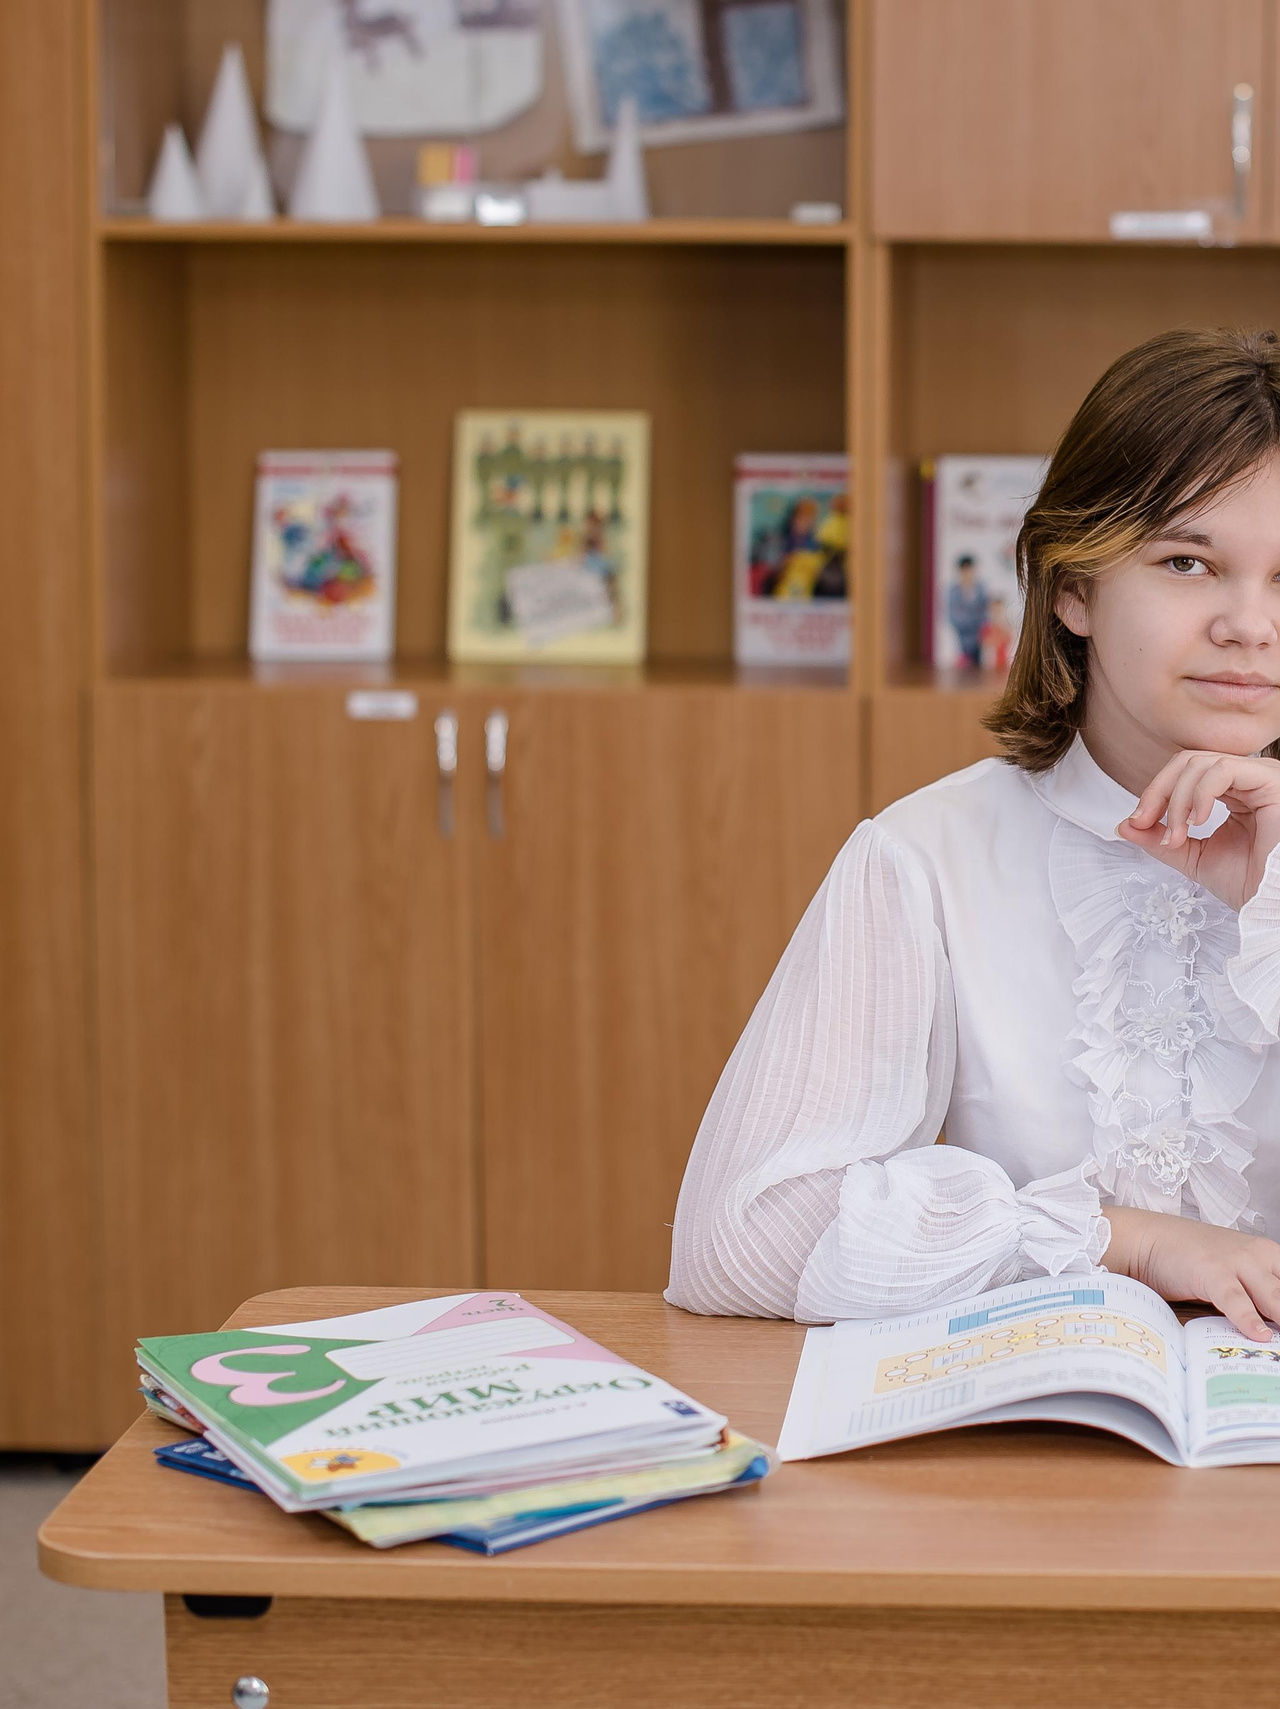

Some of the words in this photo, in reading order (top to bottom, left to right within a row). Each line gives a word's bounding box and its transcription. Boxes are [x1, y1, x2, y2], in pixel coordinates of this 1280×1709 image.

[489, 1299, 515, 1307] 2
[189, 1344, 347, 1407] 3
[367, 1380, 522, 1418] МИР
[325, 1376, 652, 1437] Окружающий
